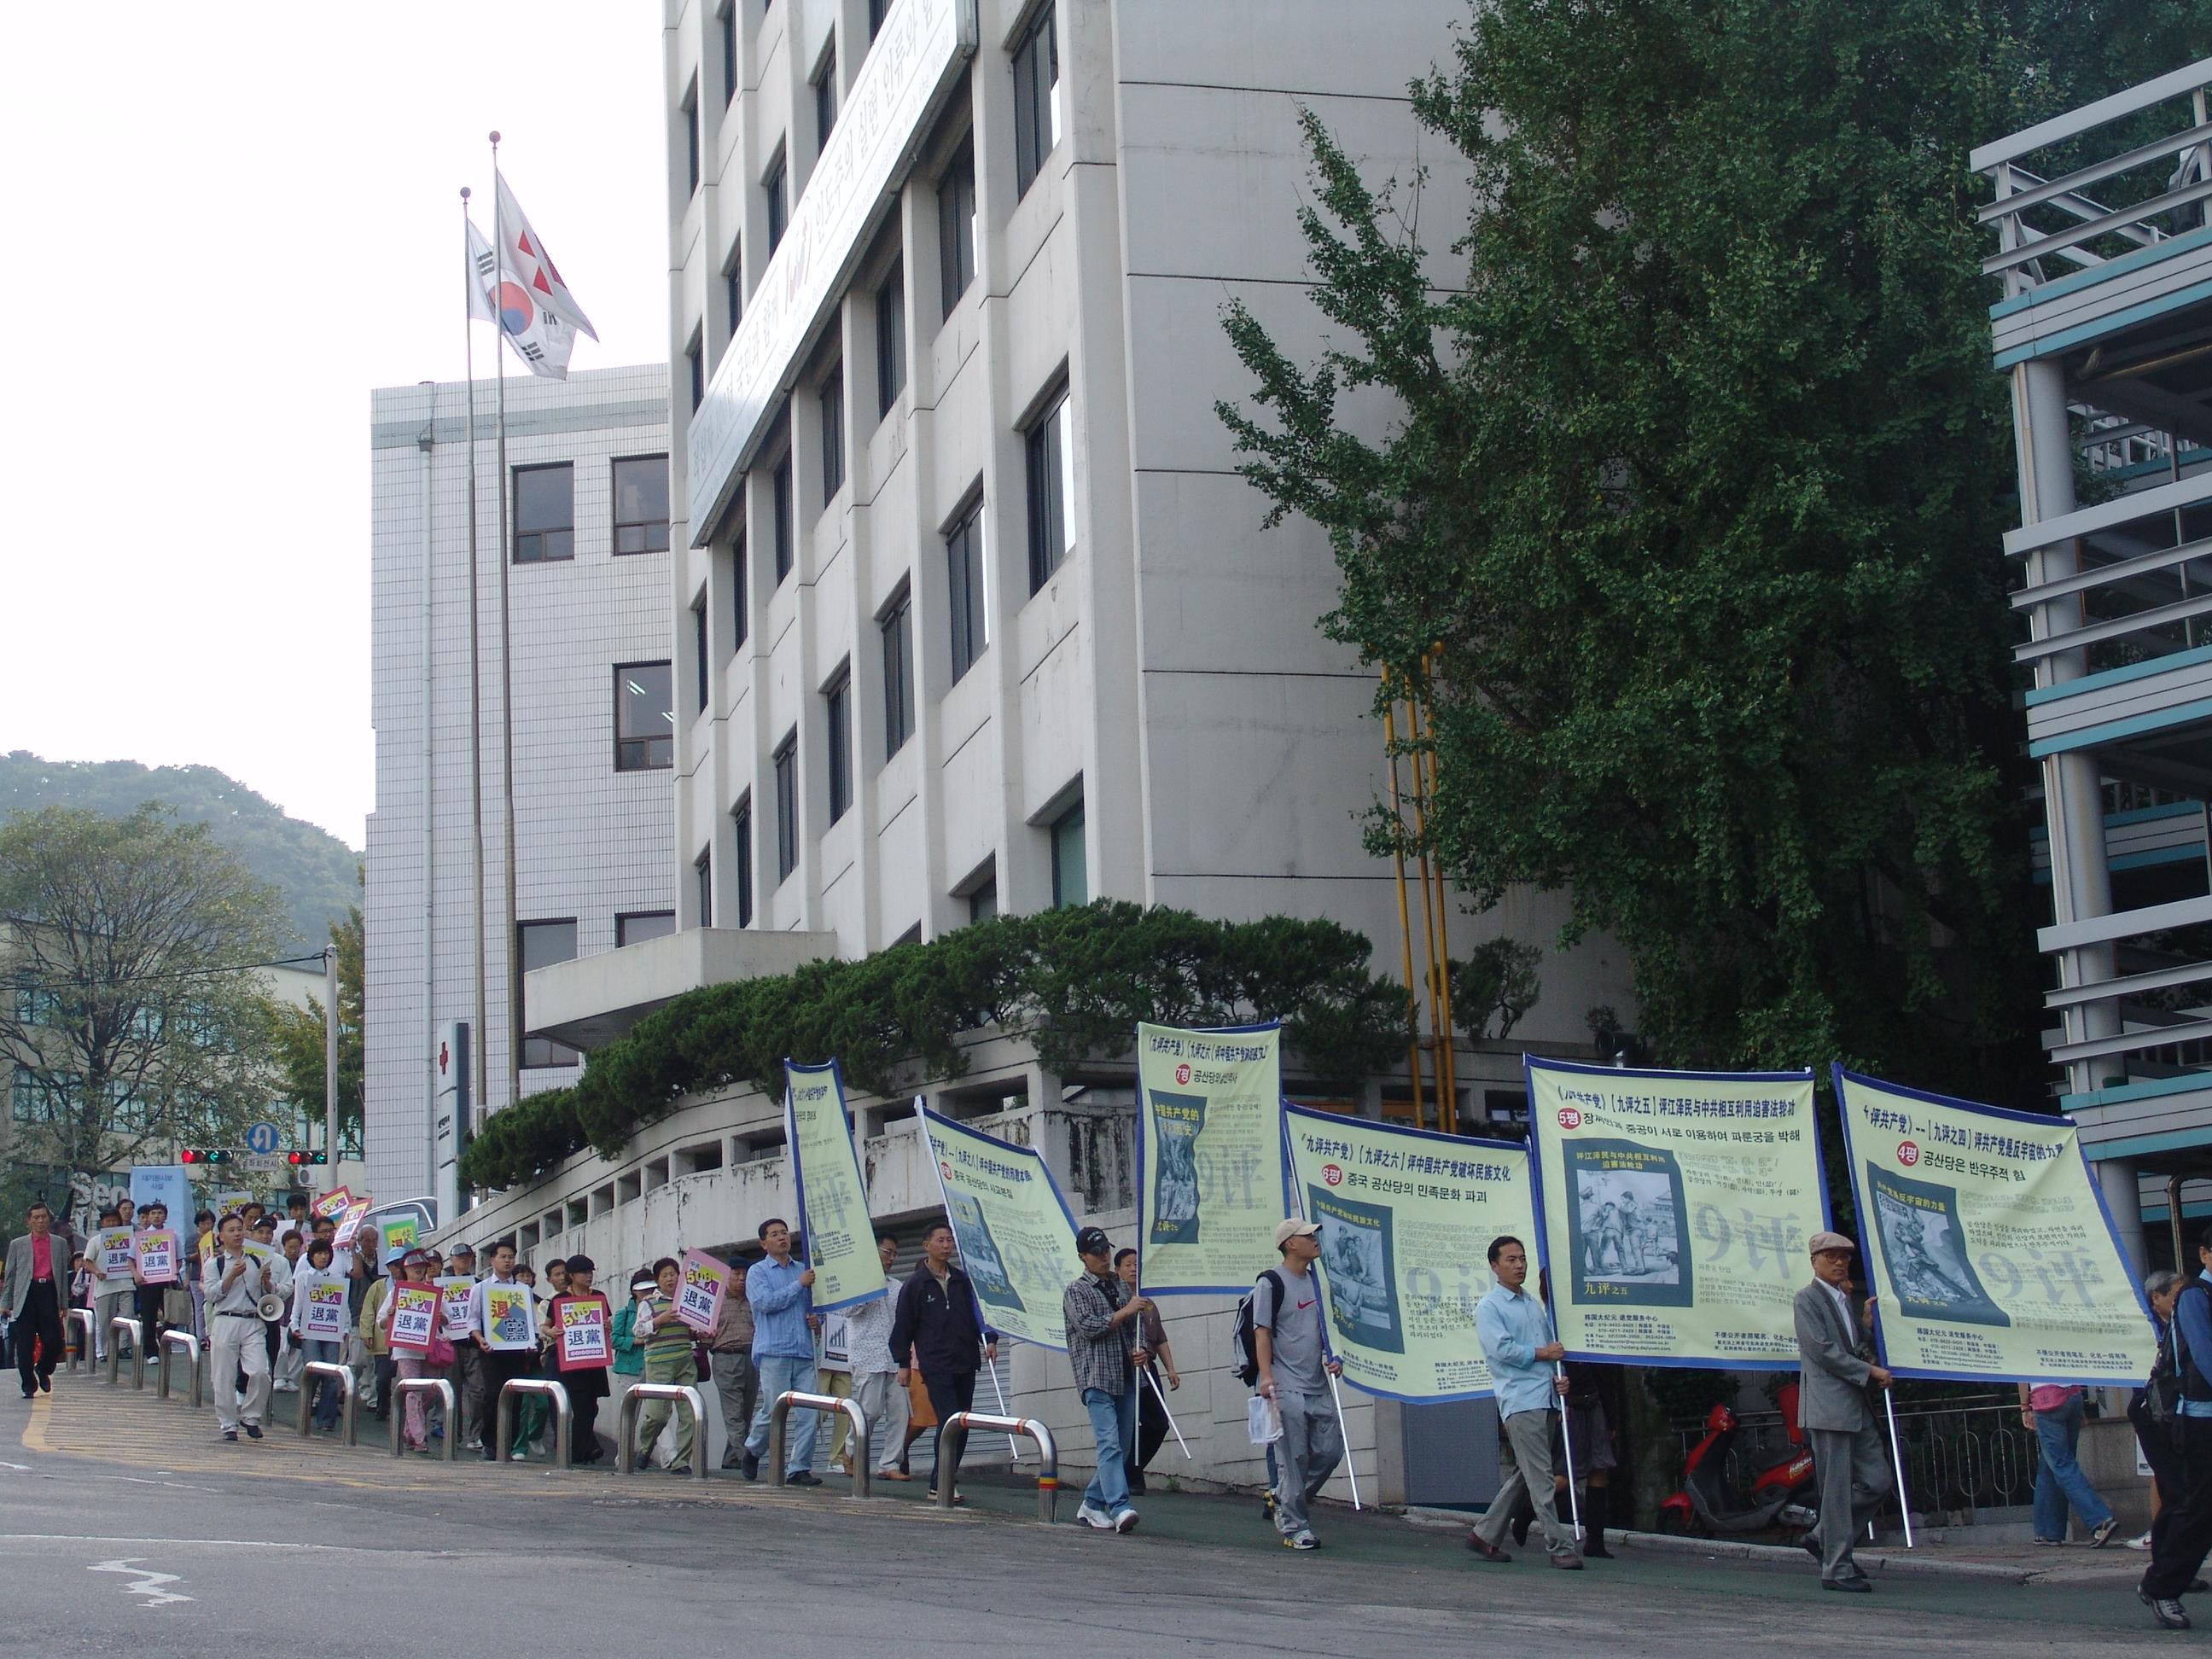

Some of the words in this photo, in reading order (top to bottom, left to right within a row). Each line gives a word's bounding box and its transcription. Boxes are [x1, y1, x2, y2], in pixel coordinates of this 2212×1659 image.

[816, 129, 854, 244] 인도주의
[860, 78, 879, 159] 실현
[883, 2, 917, 108] 인류와
[1559, 1111, 1579, 1126] 5평
[1626, 1123, 1657, 1136] 중공이
[1662, 1127, 1683, 1138] 서로
[1686, 1129, 1727, 1142] 이용하여
[1732, 1131, 1774, 1143] 파룬궁을
[1778, 1129, 1801, 1143] 박해
[1898, 1145, 1918, 1162] 4평
[1924, 1150, 1965, 1168] 공산당은
[1969, 1160, 2009, 1182] 반우주적
[1348, 1173, 1367, 1188] 중국
[1371, 1178, 1413, 1195] 공산당의
[1417, 1185, 1460, 1201] 민족문화
[1465, 1190, 1487, 1202] 파괴
[144, 1254, 168, 1268] 退黨
[507, 1292, 524, 1305] 快
[684, 1288, 713, 1314] 退黨
[311, 1307, 339, 1323] 退黨
[492, 1300, 510, 1319] 退
[397, 1314, 428, 1332] 退黨
[504, 1318, 527, 1341] 黨
[568, 1329, 601, 1346] 退黨
